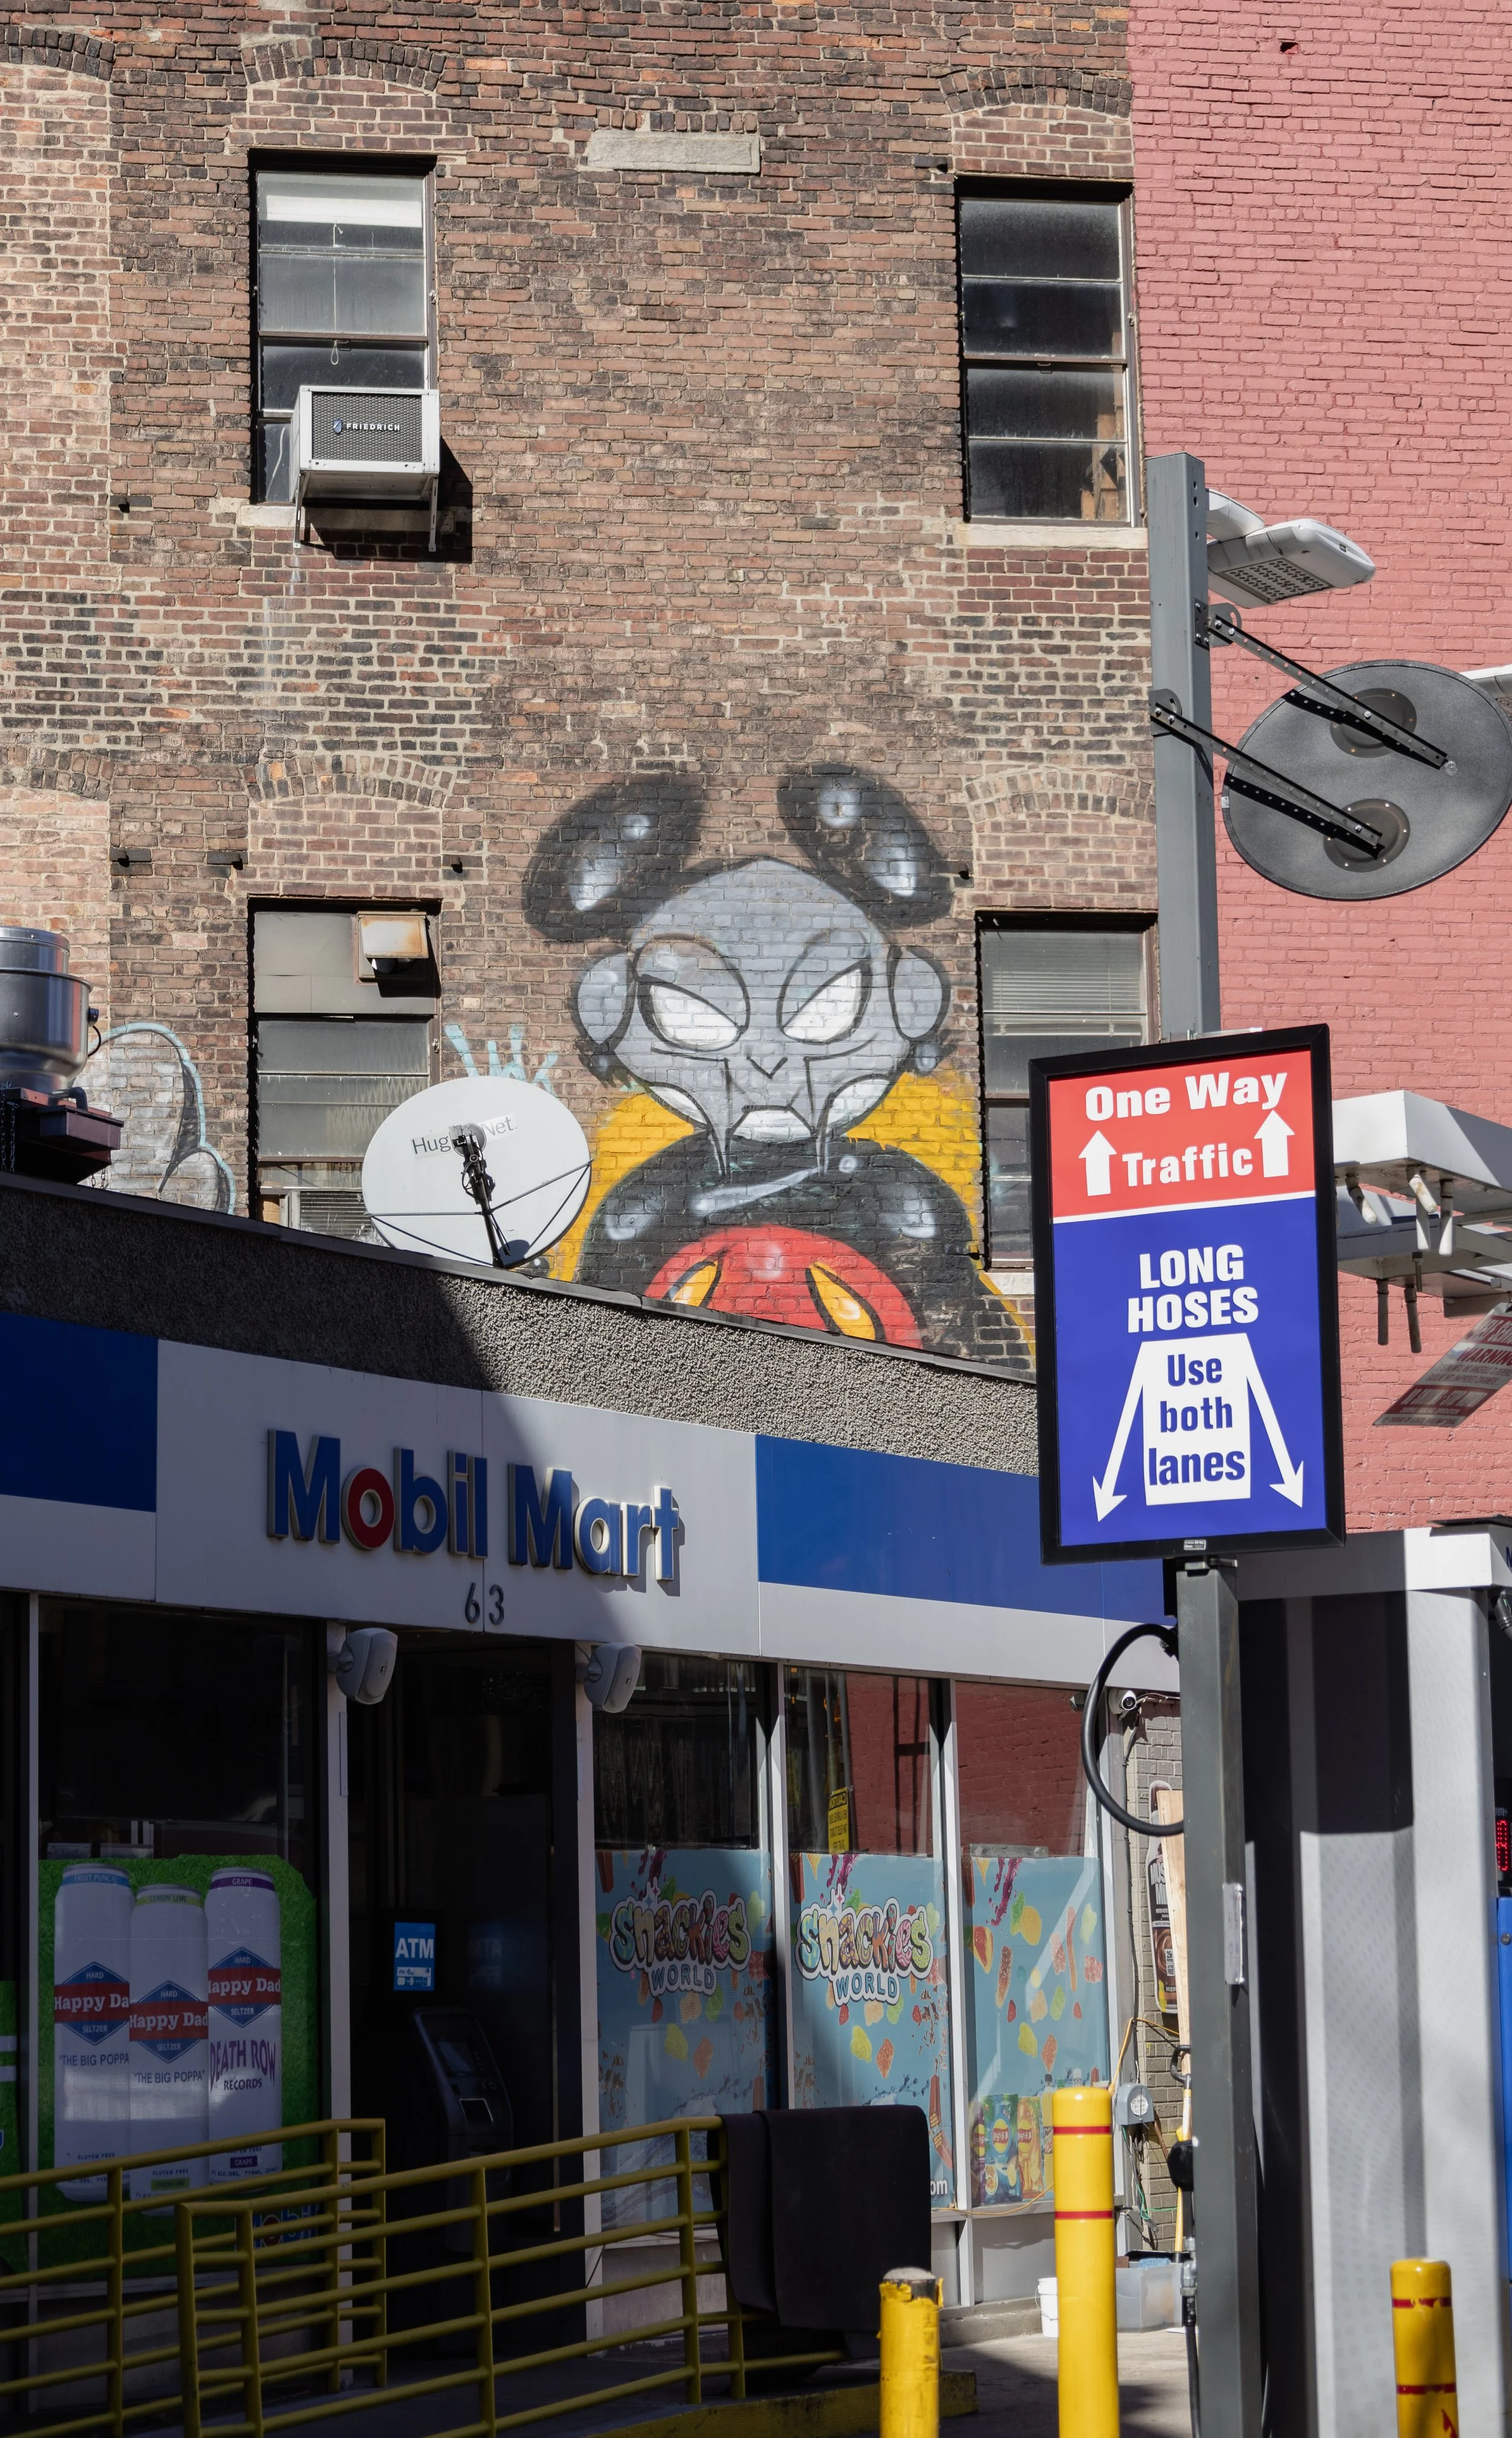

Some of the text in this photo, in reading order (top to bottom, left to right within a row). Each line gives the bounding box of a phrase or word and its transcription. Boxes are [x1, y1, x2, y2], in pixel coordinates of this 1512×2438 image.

[1086, 1072, 1287, 1122] One Way
[1123, 1143, 1253, 1188] Traffic
[1140, 1244, 1244, 1290] LONG
[1129, 1287, 1258, 1333] HOSES
[1167, 1355, 1222, 1387] Use
[1160, 1397, 1233, 1434] both
[1149, 1449, 1245, 1486] lanes
[267, 1428, 680, 1581] Mobil Mart
[464, 1582, 505, 1626] 63
[150, 1894, 171, 1903] LEMON
[395, 1938, 434, 1959] ATM
[256, 1977, 281, 1993] Dad
[651, 1964, 715, 1991] WORLD
[836, 1972, 898, 1999] WORLD
[54, 1995, 106, 2013] Happy
[161, 1990, 178, 1998] HARD
[129, 2012, 208, 2031] Happy Dad
[230, 2008, 255, 2016] SELTZER
[82, 2025, 108, 2033] SELTZER
[157, 2042, 181, 2051] SELTZER
[80, 2054, 97, 2067] BIG
[210, 2039, 276, 2093] DEATH ROW
[155, 2072, 171, 2084] BIG
[224, 2078, 262, 2091] RECORDS
